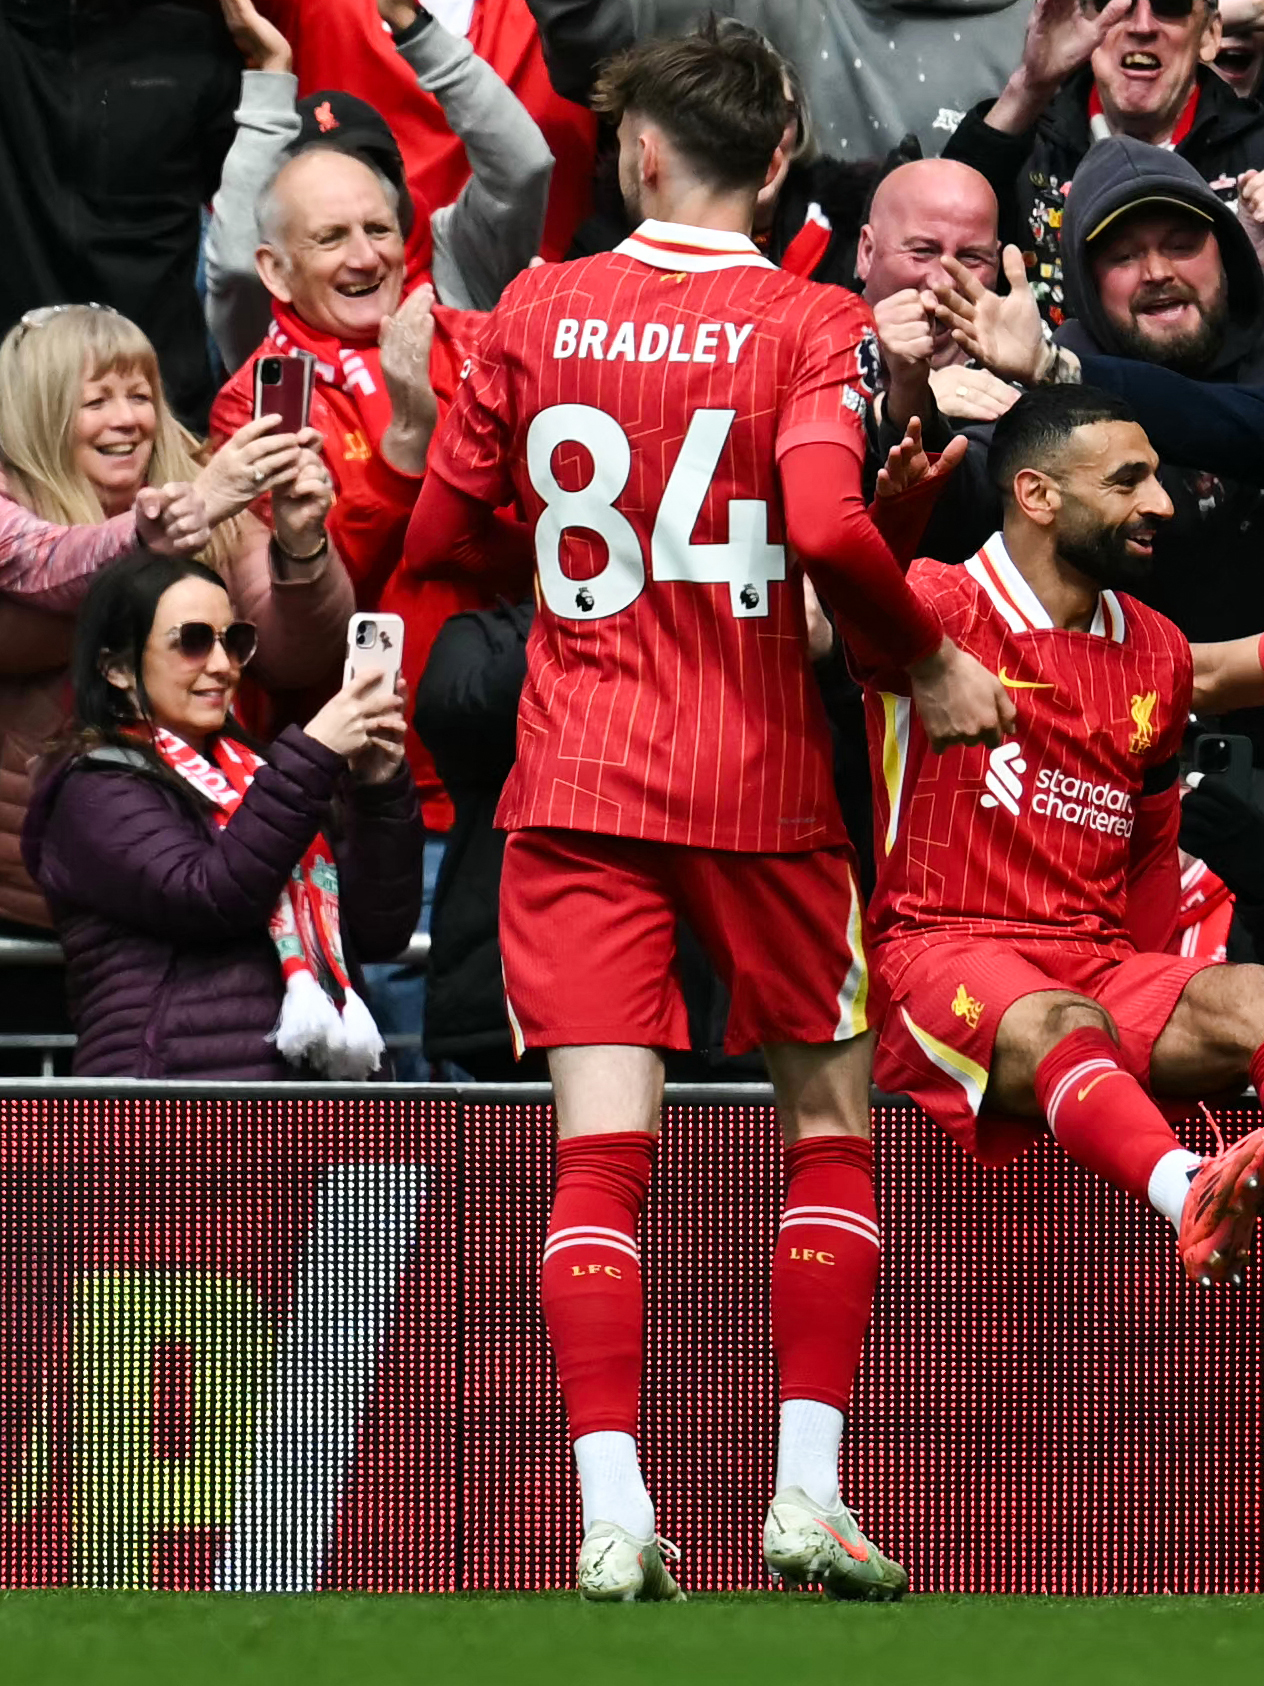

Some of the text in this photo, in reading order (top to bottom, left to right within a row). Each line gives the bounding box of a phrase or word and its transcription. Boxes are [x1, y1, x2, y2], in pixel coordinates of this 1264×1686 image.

[553, 318, 754, 363] BRADLEY
[526, 402, 786, 621] 84
[1035, 769, 1133, 814] standar
[1032, 793, 1135, 838] chartered
[571, 1264, 622, 1280] LFC
[790, 1247, 835, 1266] LFC
